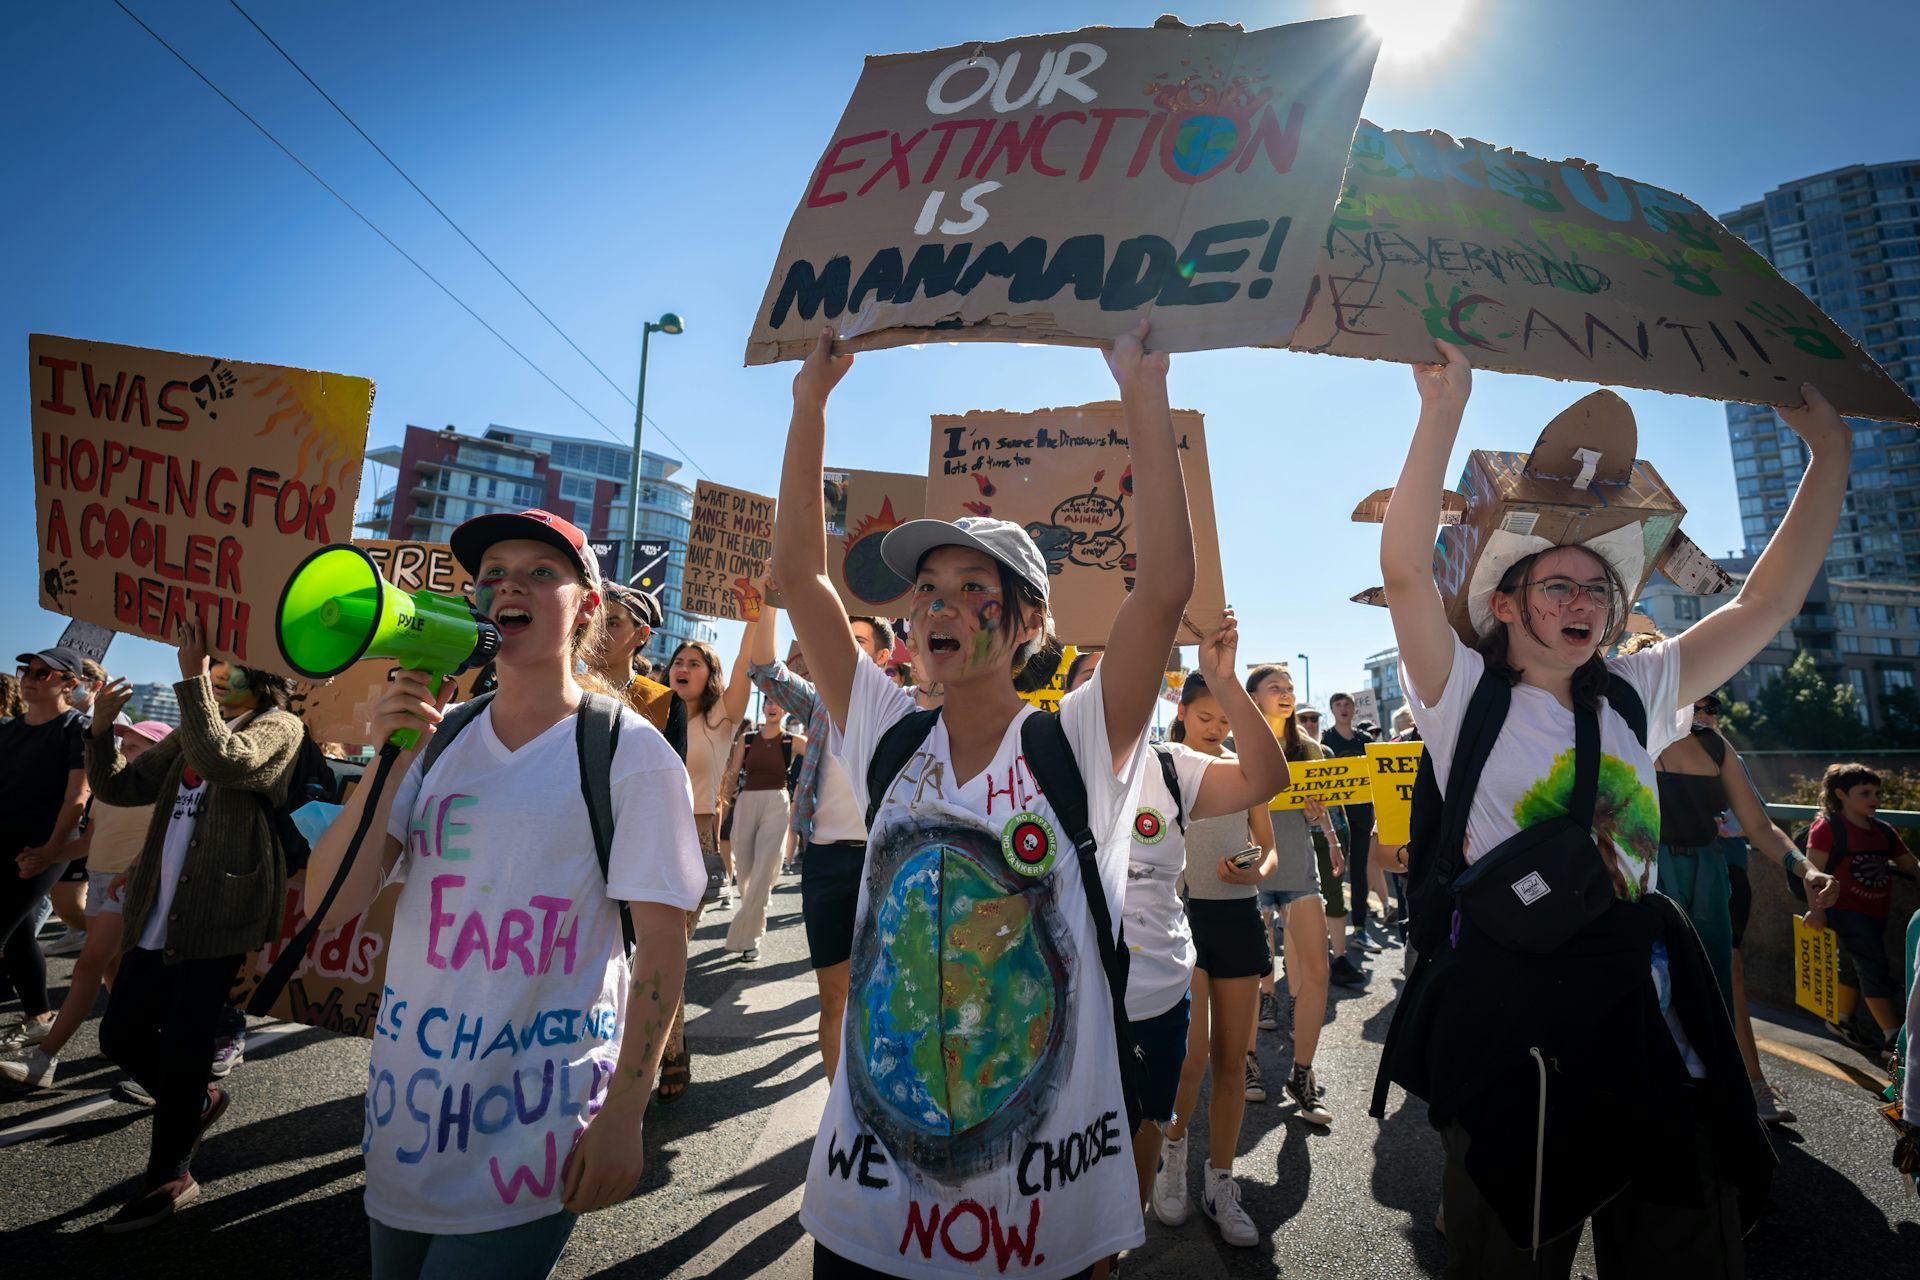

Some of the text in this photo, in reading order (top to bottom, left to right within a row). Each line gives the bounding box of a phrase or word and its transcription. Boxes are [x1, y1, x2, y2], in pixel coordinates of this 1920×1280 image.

[926, 42, 1108, 114] OUR
[807, 104, 1306, 208] EXTINCTION
[914, 182, 1003, 235] IS
[769, 217, 1292, 328] MANMADE!
[1327, 224, 1611, 294] NEVERMIND
[1448, 293, 1788, 381] CAN'T!!
[38, 356, 191, 431] I WAS
[42, 432, 336, 545] HOPING FOR
[694, 505, 772, 538] DANCE MOVES
[699, 487, 771, 520] WHAT DO MY
[46, 499, 244, 594] A COOLER
[688, 543, 765, 578] HAVE IN COMMO
[693, 524, 772, 560] AND THE EARTH
[114, 571, 250, 660] DEATH
[397, 613, 425, 632] PYLE
[685, 596, 737, 619] BOTH ON
[686, 581, 736, 606] THEY'RE
[1304, 766, 1349, 779] END
[1003, 834, 1047, 875] NO TANKERS
[1015, 813, 1057, 857] NO PIPELINES
[426, 874, 578, 976] EARTH
[1800, 938, 1811, 991] DOME
[1813, 935, 1822, 1006] THE HEAT
[1823, 930, 1834, 1019] REMEMBER
[375, 985, 407, 1042] IS
[489, 1127, 584, 1205] W
[827, 1111, 1122, 1197] WE CHOOSE
[899, 1198, 1046, 1275] NOW.
